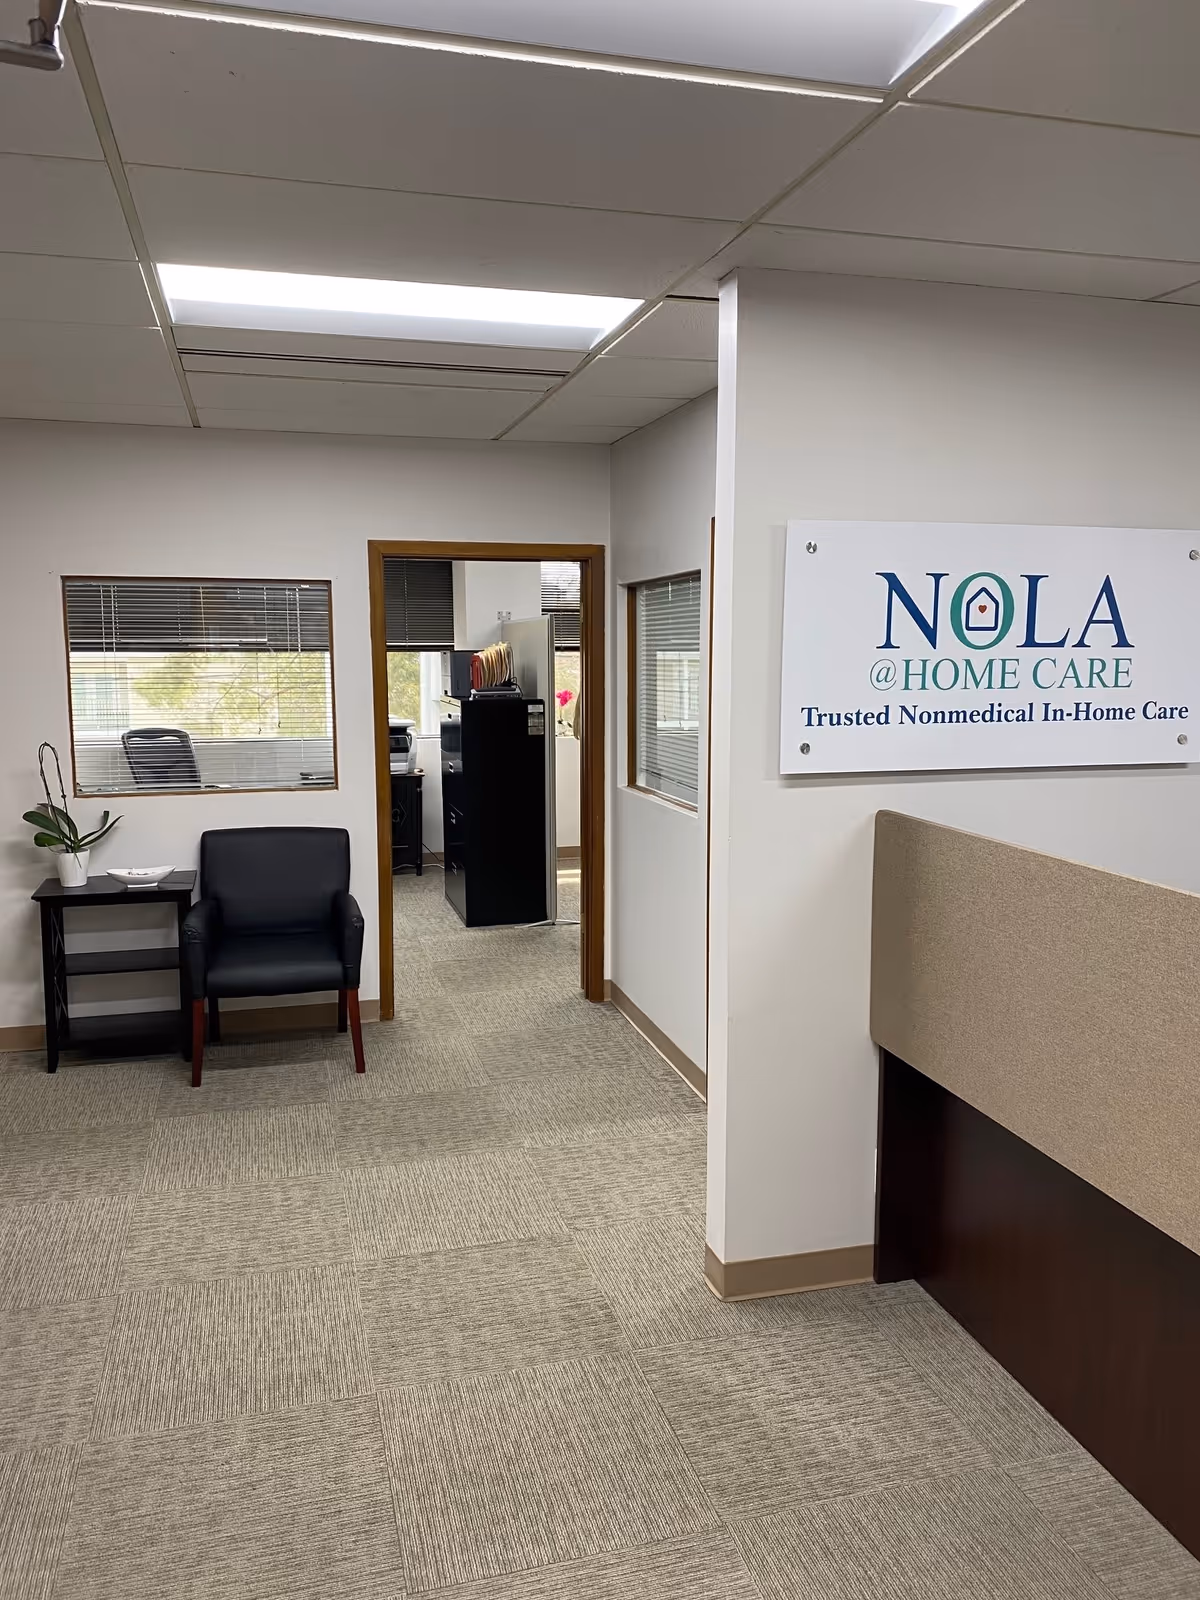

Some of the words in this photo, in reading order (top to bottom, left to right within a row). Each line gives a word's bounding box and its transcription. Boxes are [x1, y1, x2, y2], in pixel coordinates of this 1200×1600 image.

[875, 572, 1135, 650] NOLA
[1033, 658, 1132, 690] CARE
[801, 705, 890, 727] Trusted
[898, 702, 1034, 725] Nonmedical
[1042, 702, 1135, 722] In-Home
[1142, 701, 1188, 720] Care
